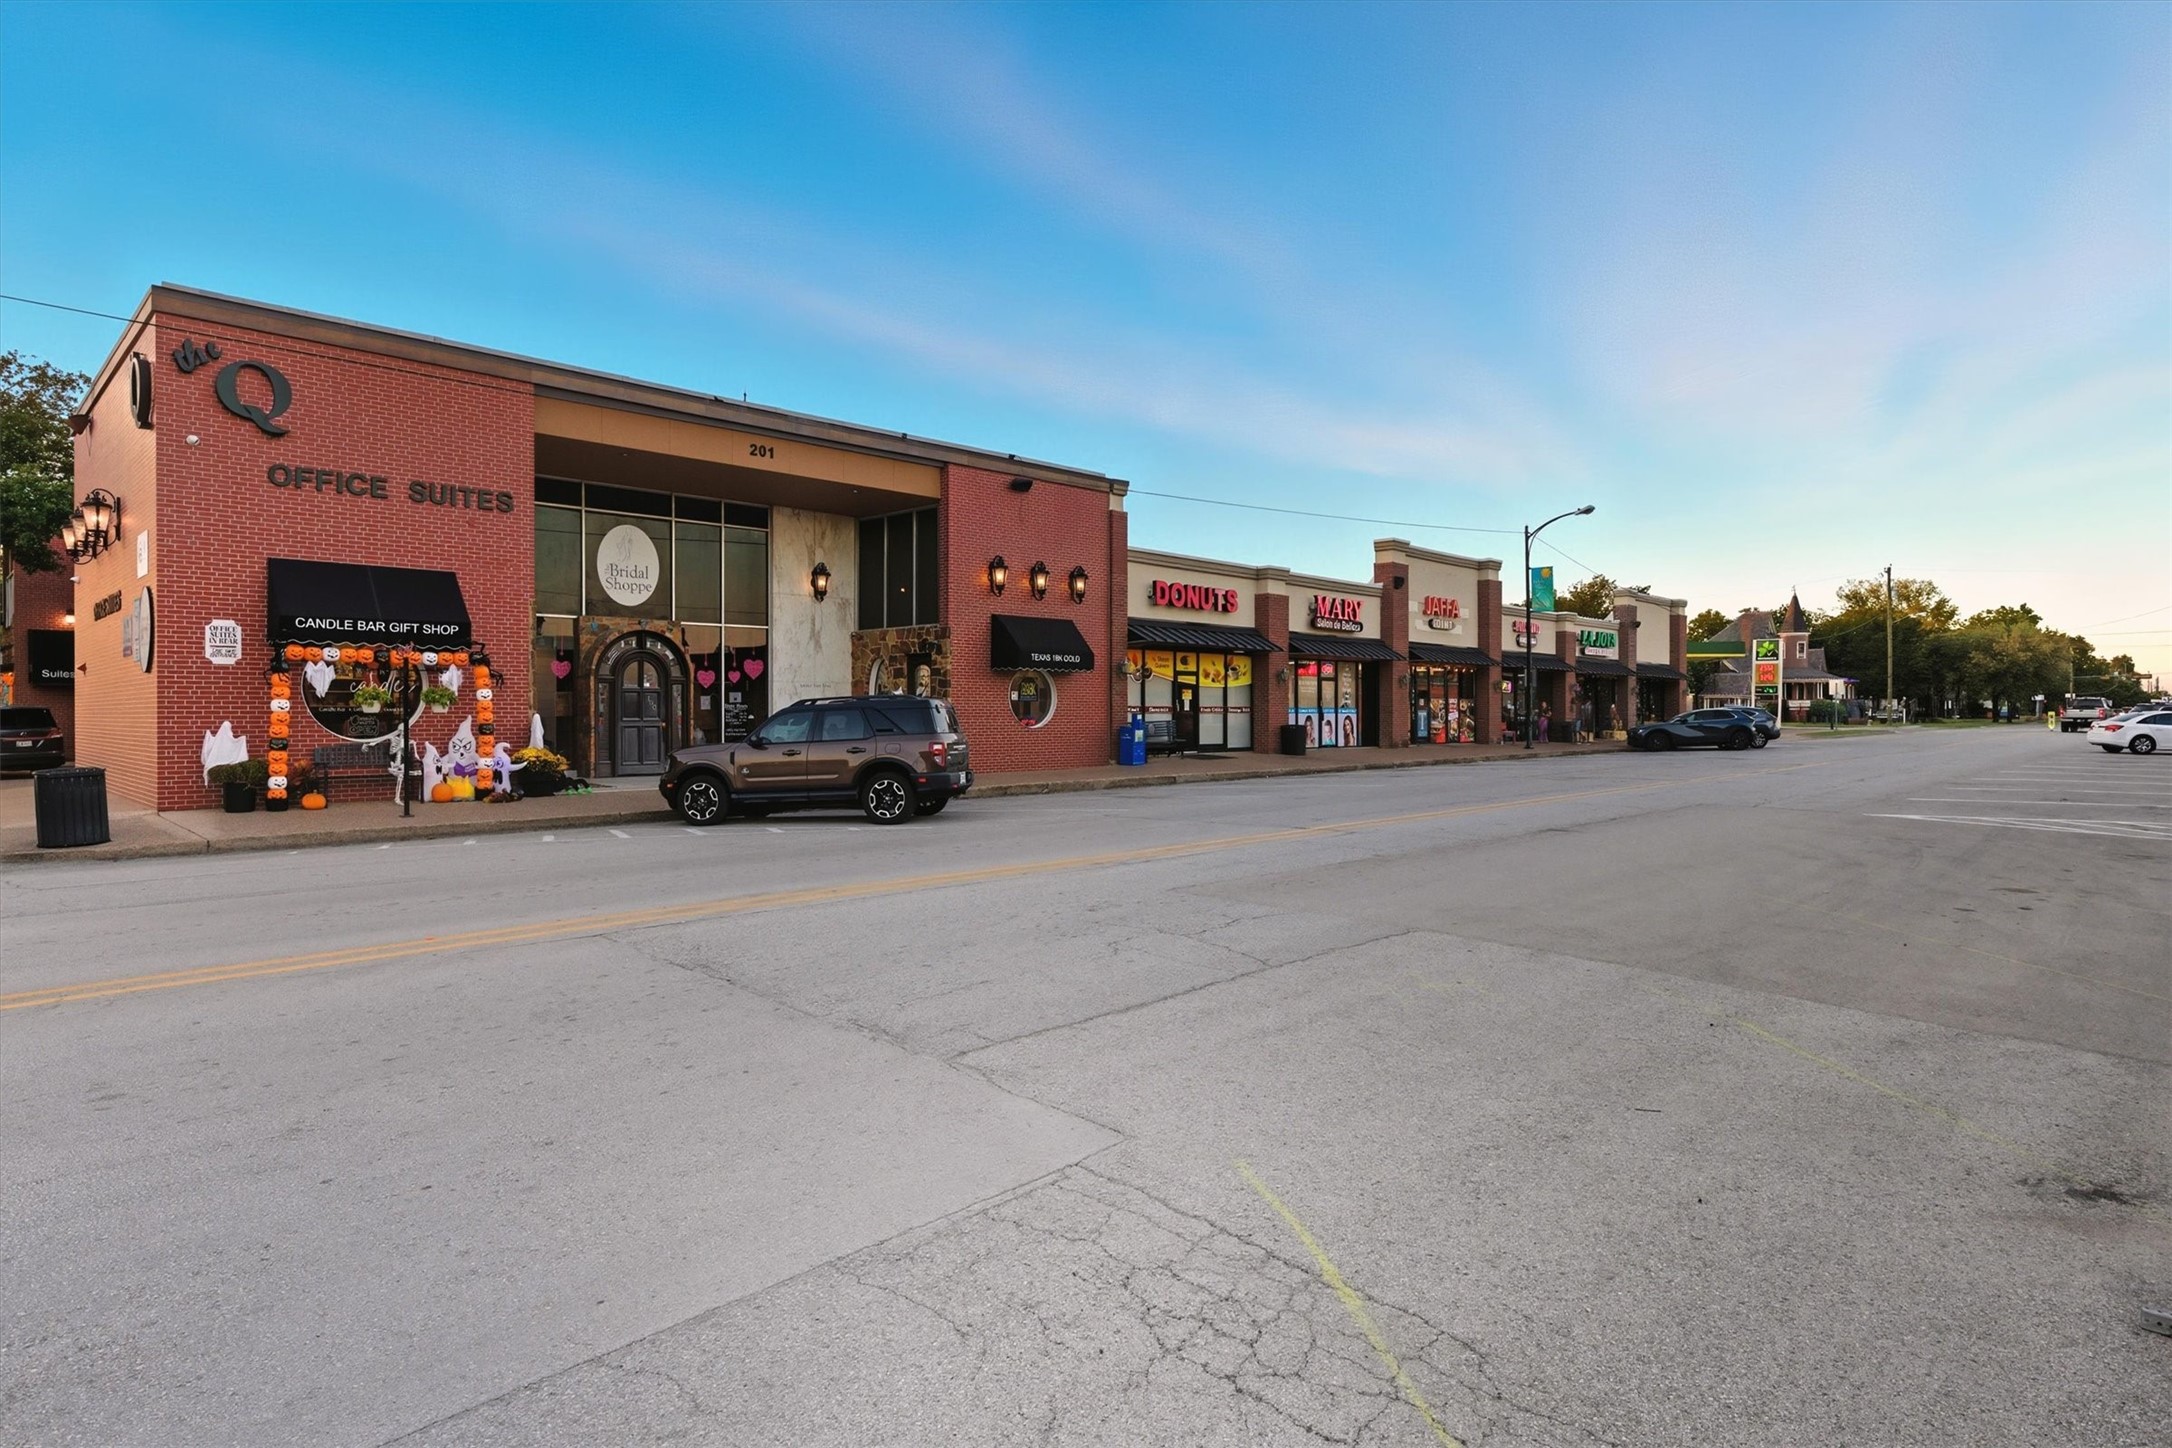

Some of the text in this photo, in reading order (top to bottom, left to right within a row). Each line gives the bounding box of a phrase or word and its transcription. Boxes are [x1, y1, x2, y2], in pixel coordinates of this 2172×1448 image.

[172, 338, 222, 374] the
[215, 360, 293, 437] Q
[749, 443, 774, 459] 201
[267, 463, 514, 513] OFFICE SUITES
[609, 563, 649, 580] Bridal
[605, 576, 653, 595] Shoppe
[1152, 579, 1239, 614] DONUTS
[1423, 595, 1461, 619] JAFFA
[1314, 594, 1363, 622] MARY
[295, 617, 459, 635] CANDLE BAR GIFT SHOP
[1031, 653, 1051, 662] TEXAS
[41, 668, 75, 678] Suites
